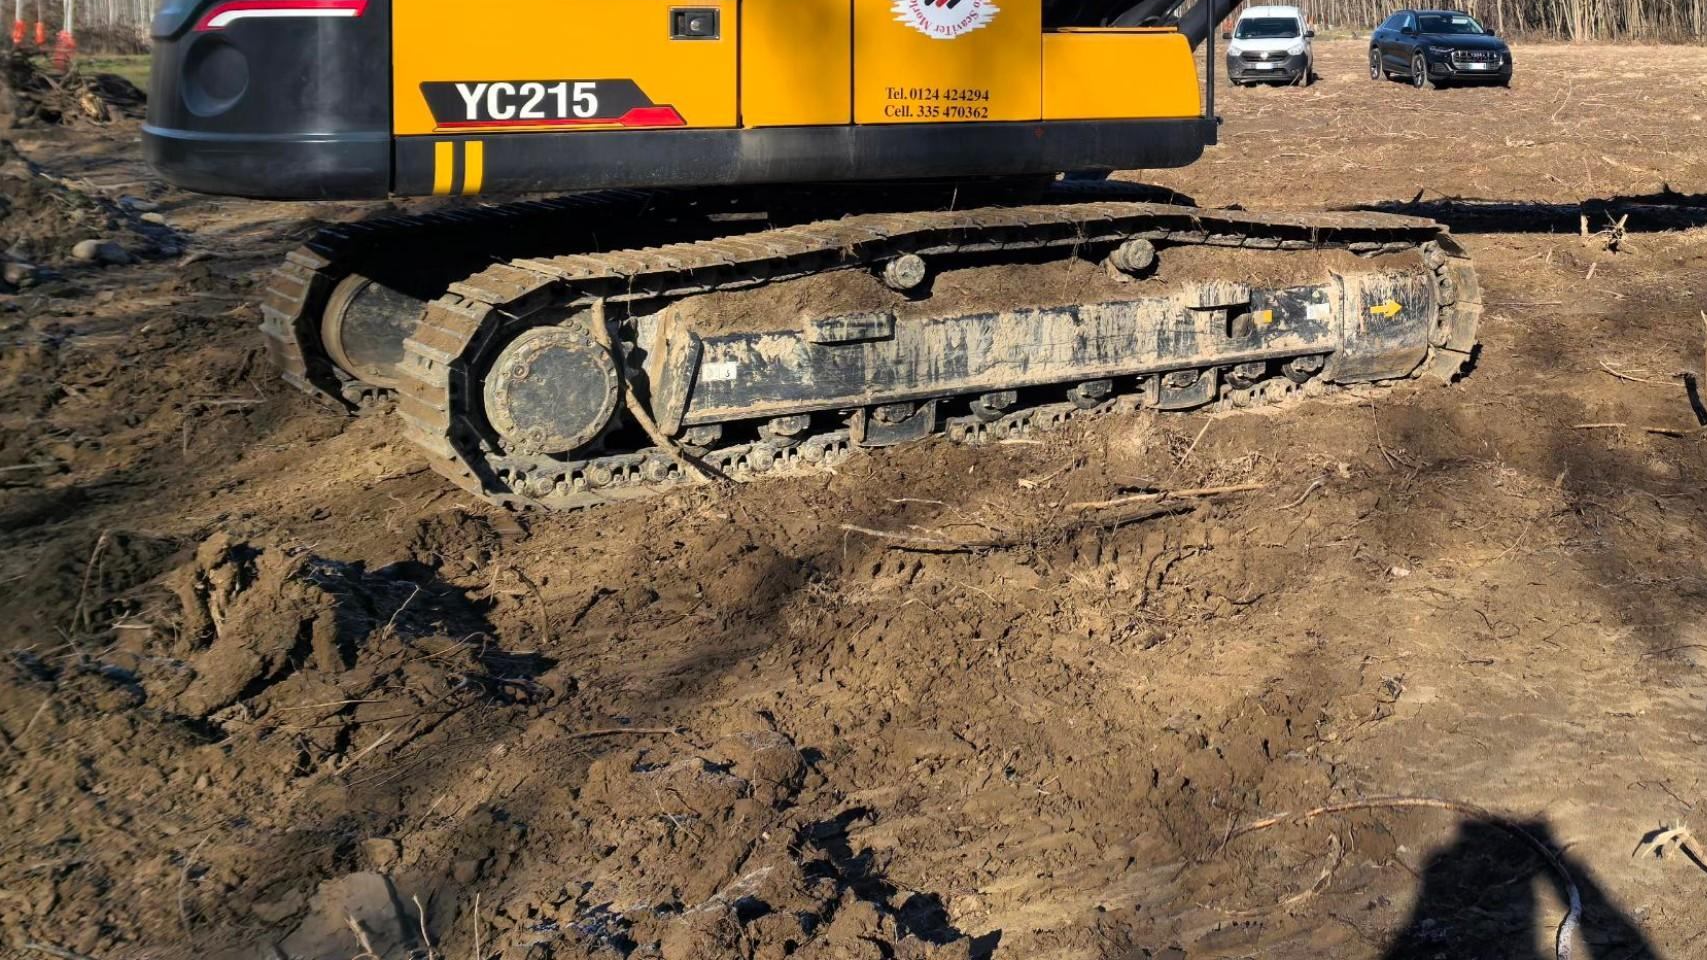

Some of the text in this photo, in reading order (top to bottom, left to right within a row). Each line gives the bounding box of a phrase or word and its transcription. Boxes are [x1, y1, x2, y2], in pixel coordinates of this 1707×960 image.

[455, 82, 598, 120] YC215
[885, 87, 989, 101] Tel. 0124 424294
[884, 105, 988, 118] Cell. 335 470362
